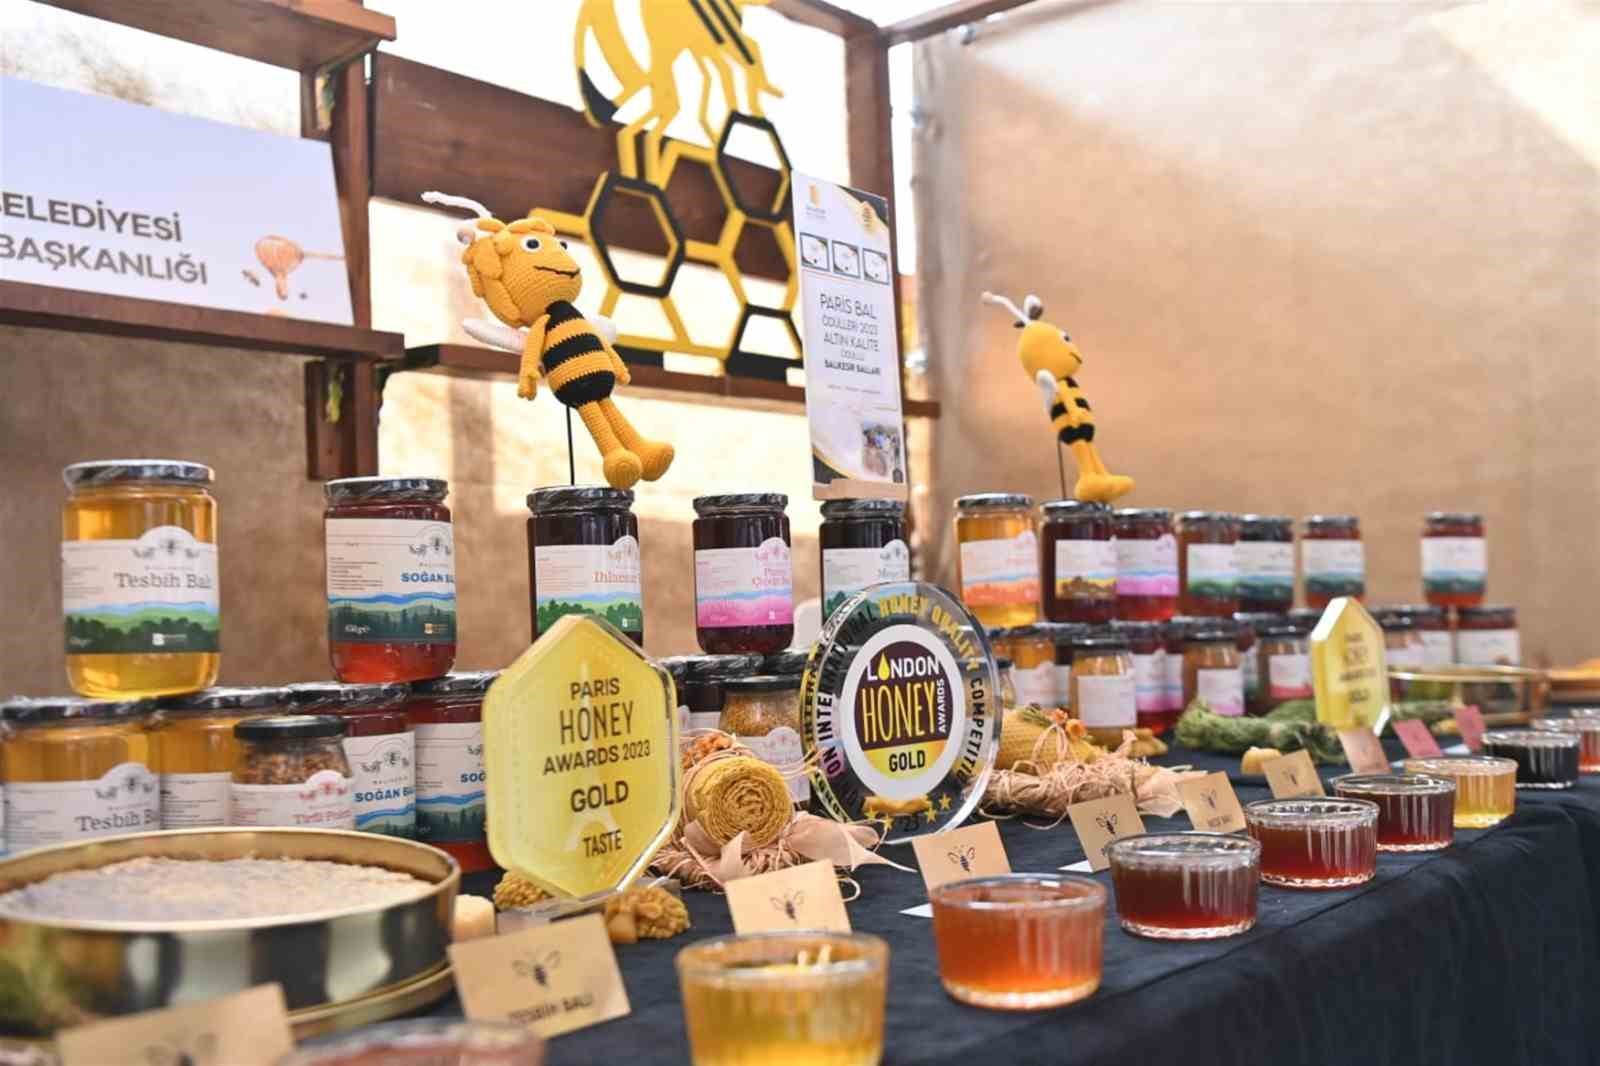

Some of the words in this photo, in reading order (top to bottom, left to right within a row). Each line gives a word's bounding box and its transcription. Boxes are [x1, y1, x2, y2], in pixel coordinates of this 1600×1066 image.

[0, 191, 182, 242] ELEDİYESİ
[113, 572, 180, 589] Tesbih
[400, 570, 444, 583] SOĞAN
[878, 592, 930, 618] HONEY
[931, 606, 980, 671] QUALITY
[867, 656, 939, 682] LONDON
[571, 677, 620, 700] PARIS
[861, 682, 936, 743] HONEY
[937, 678, 948, 734] AWARDS
[560, 700, 635, 745] HONEY
[956, 677, 985, 783] COMPETITIO
[543, 745, 620, 776] AWARDS
[622, 739, 651, 761] 2023
[889, 750, 926, 772] GOLD
[461, 771, 485, 784] SOĞ
[355, 789, 400, 803] SOĞAN
[571, 780, 629, 812] GOLD
[74, 811, 141, 832] Tesbih
[583, 829, 622, 857] TASTE
